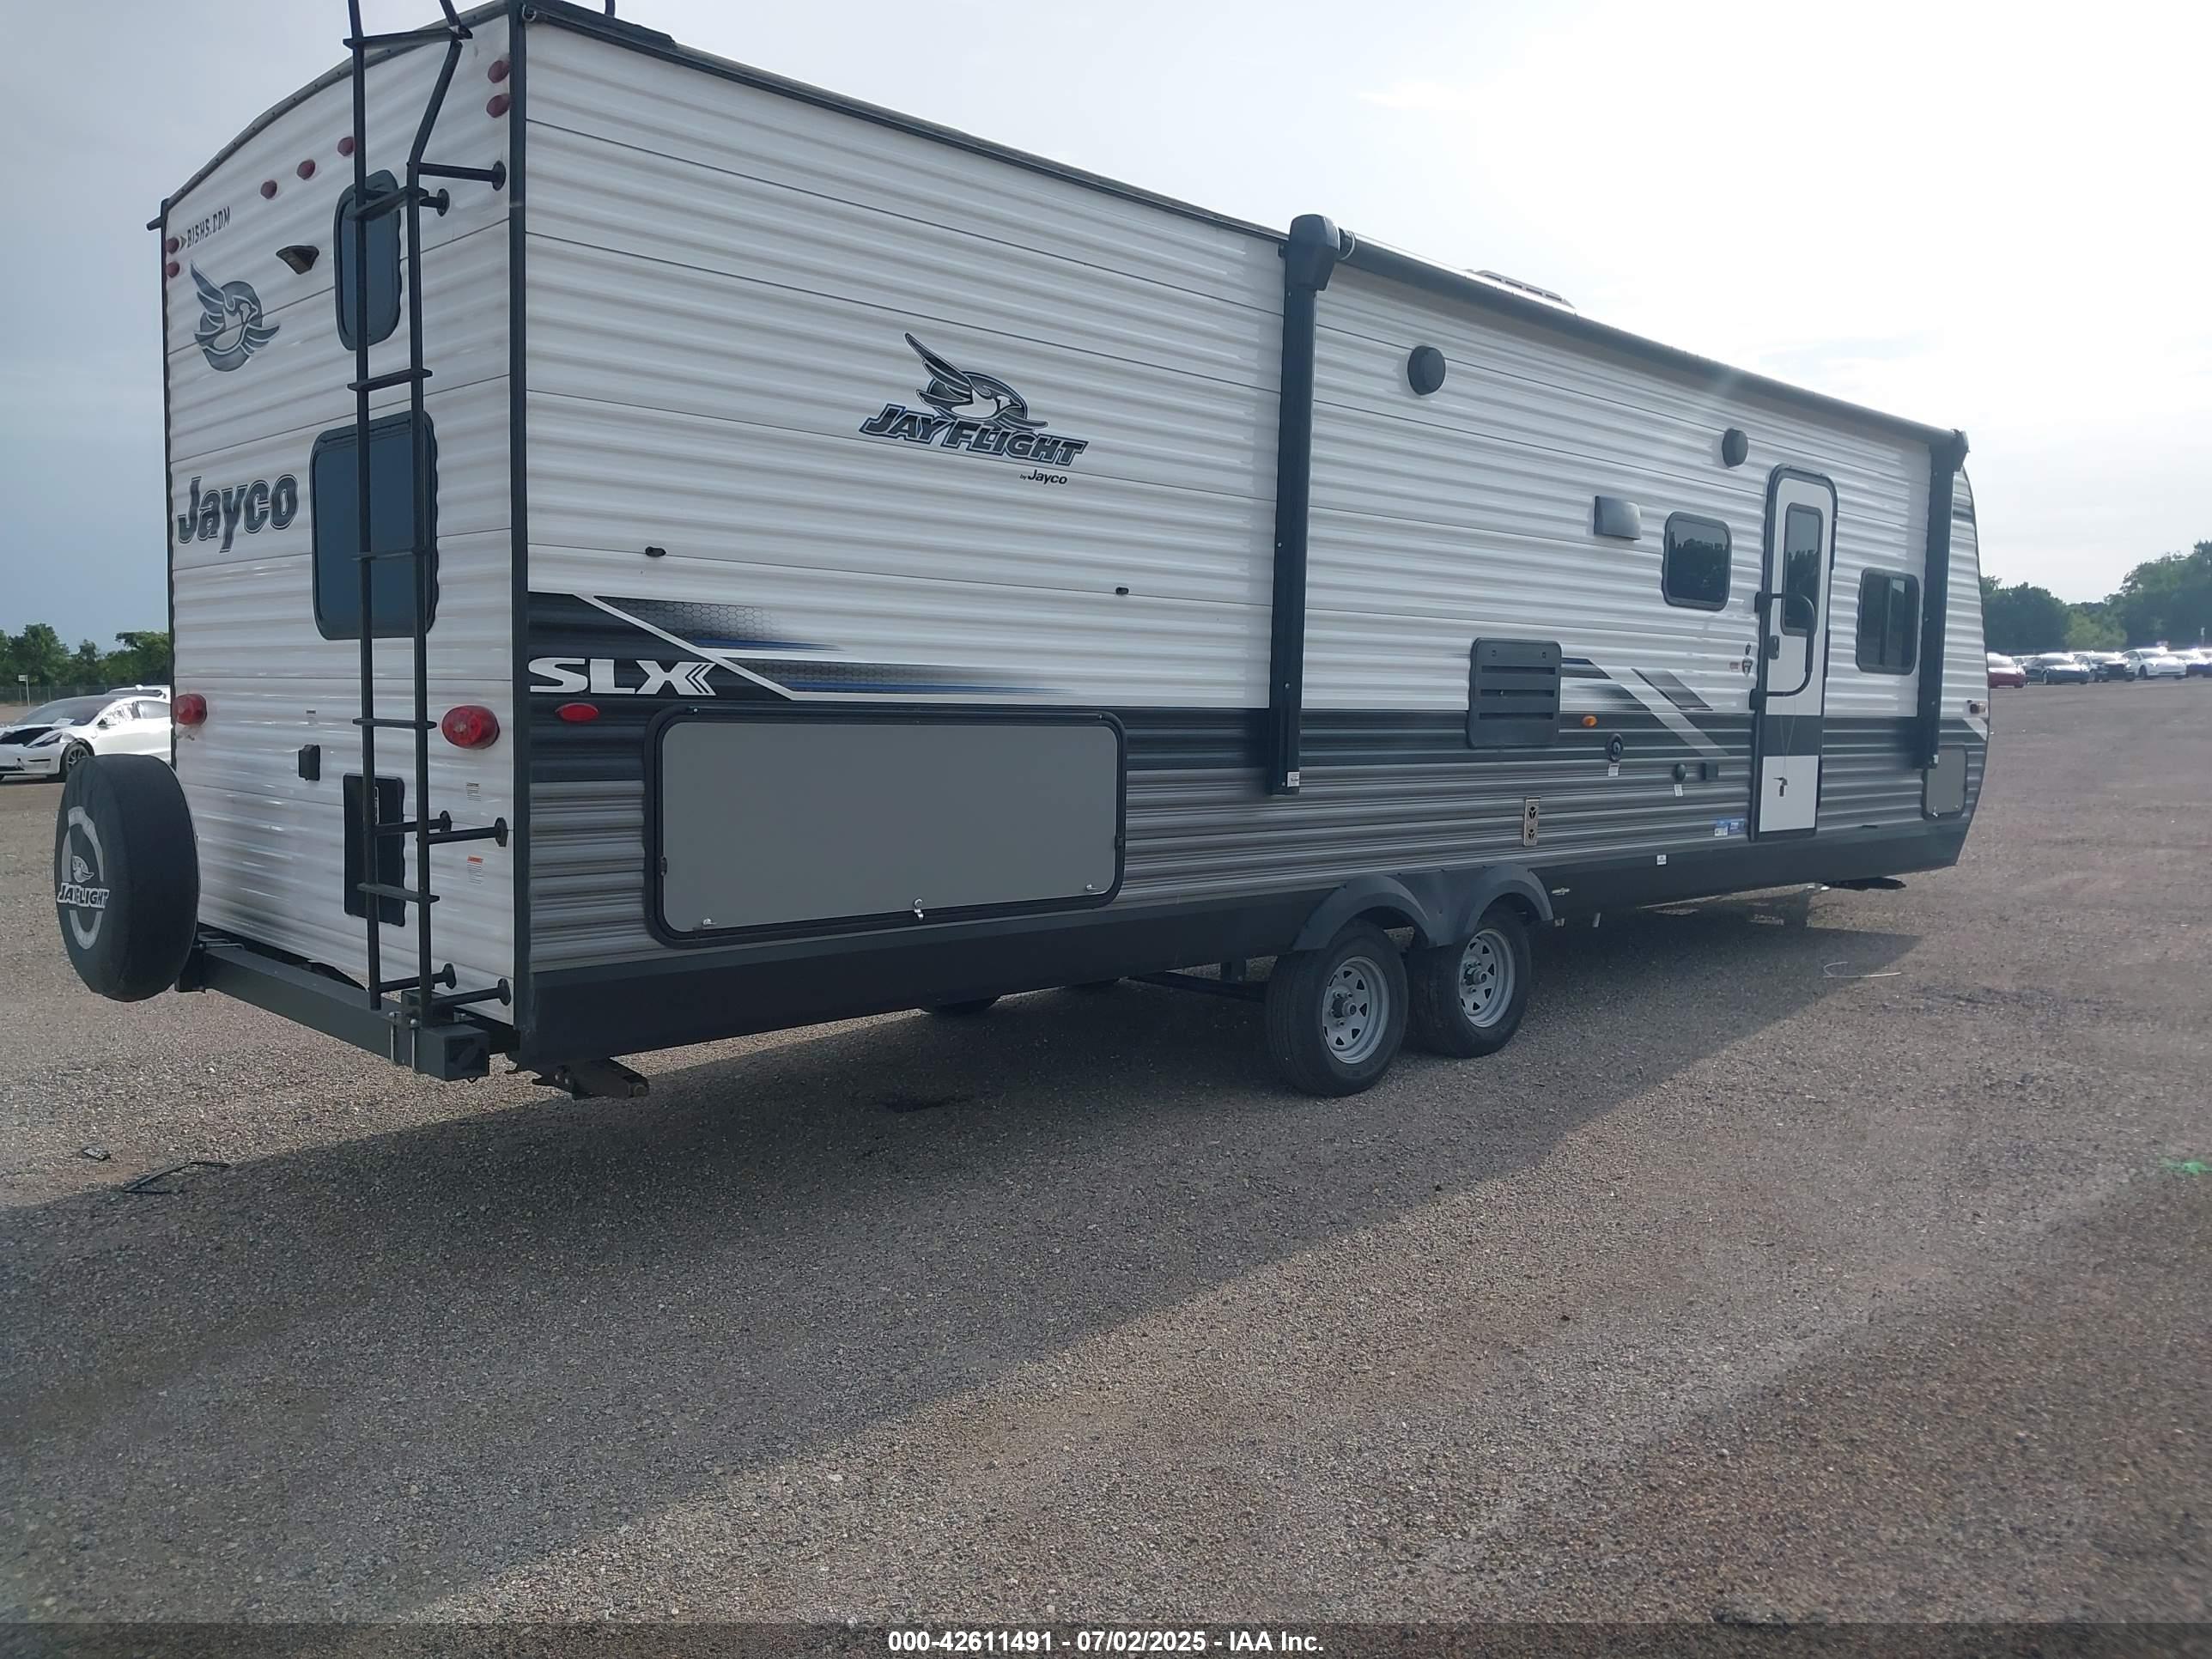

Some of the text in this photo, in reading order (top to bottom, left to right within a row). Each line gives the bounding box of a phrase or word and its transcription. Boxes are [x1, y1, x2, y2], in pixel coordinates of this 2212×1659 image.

[186, 206, 231, 248] BISHS.COM
[859, 404, 1089, 467] JAY FLIGHT
[1027, 469, 1068, 485] Jayco
[178, 474, 298, 553] Jayco
[528, 657, 717, 696] SLX
